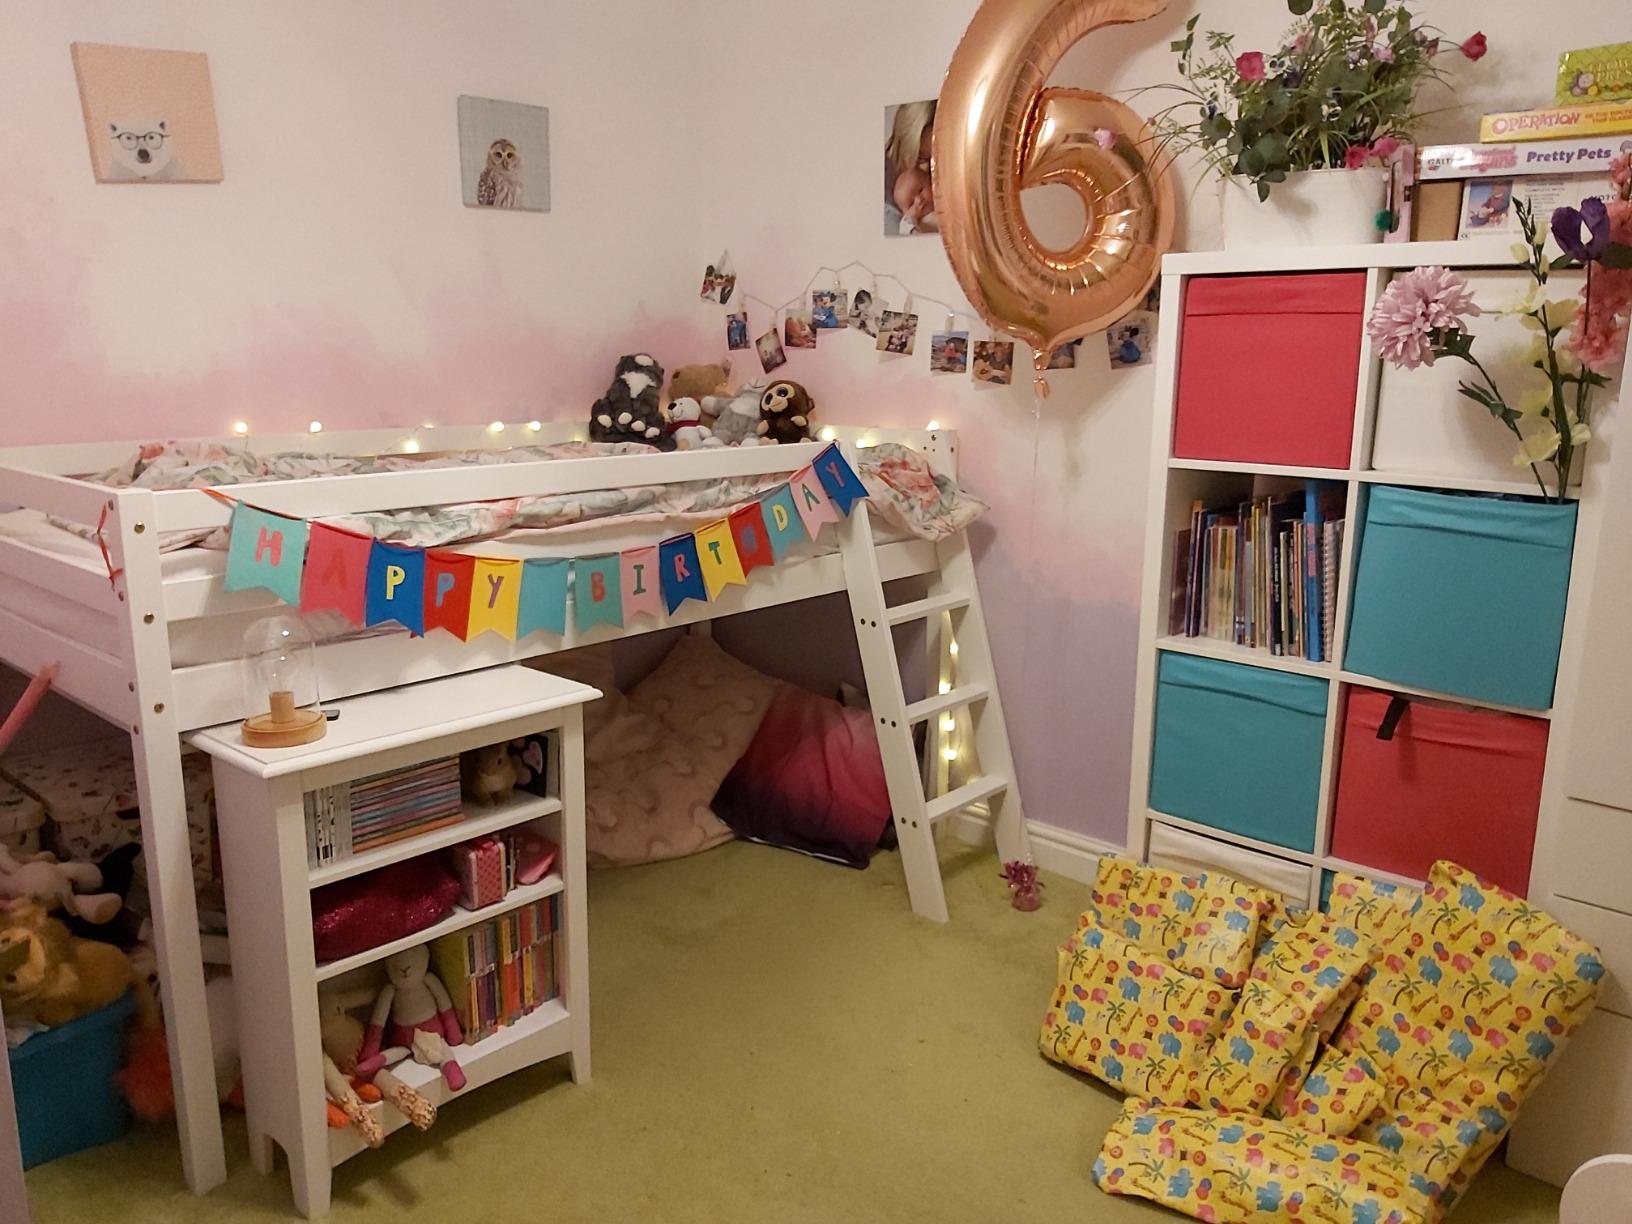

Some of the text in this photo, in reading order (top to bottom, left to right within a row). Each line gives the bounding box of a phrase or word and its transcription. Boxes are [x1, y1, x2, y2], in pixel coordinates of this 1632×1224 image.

[1491, 112, 1580, 135] OPERATION
[931, 0, 1175, 345] 6
[1526, 150, 1575, 163] Pretty
[1577, 147, 1612, 160] Pets
[254, 526, 505, 609] HAPPY
